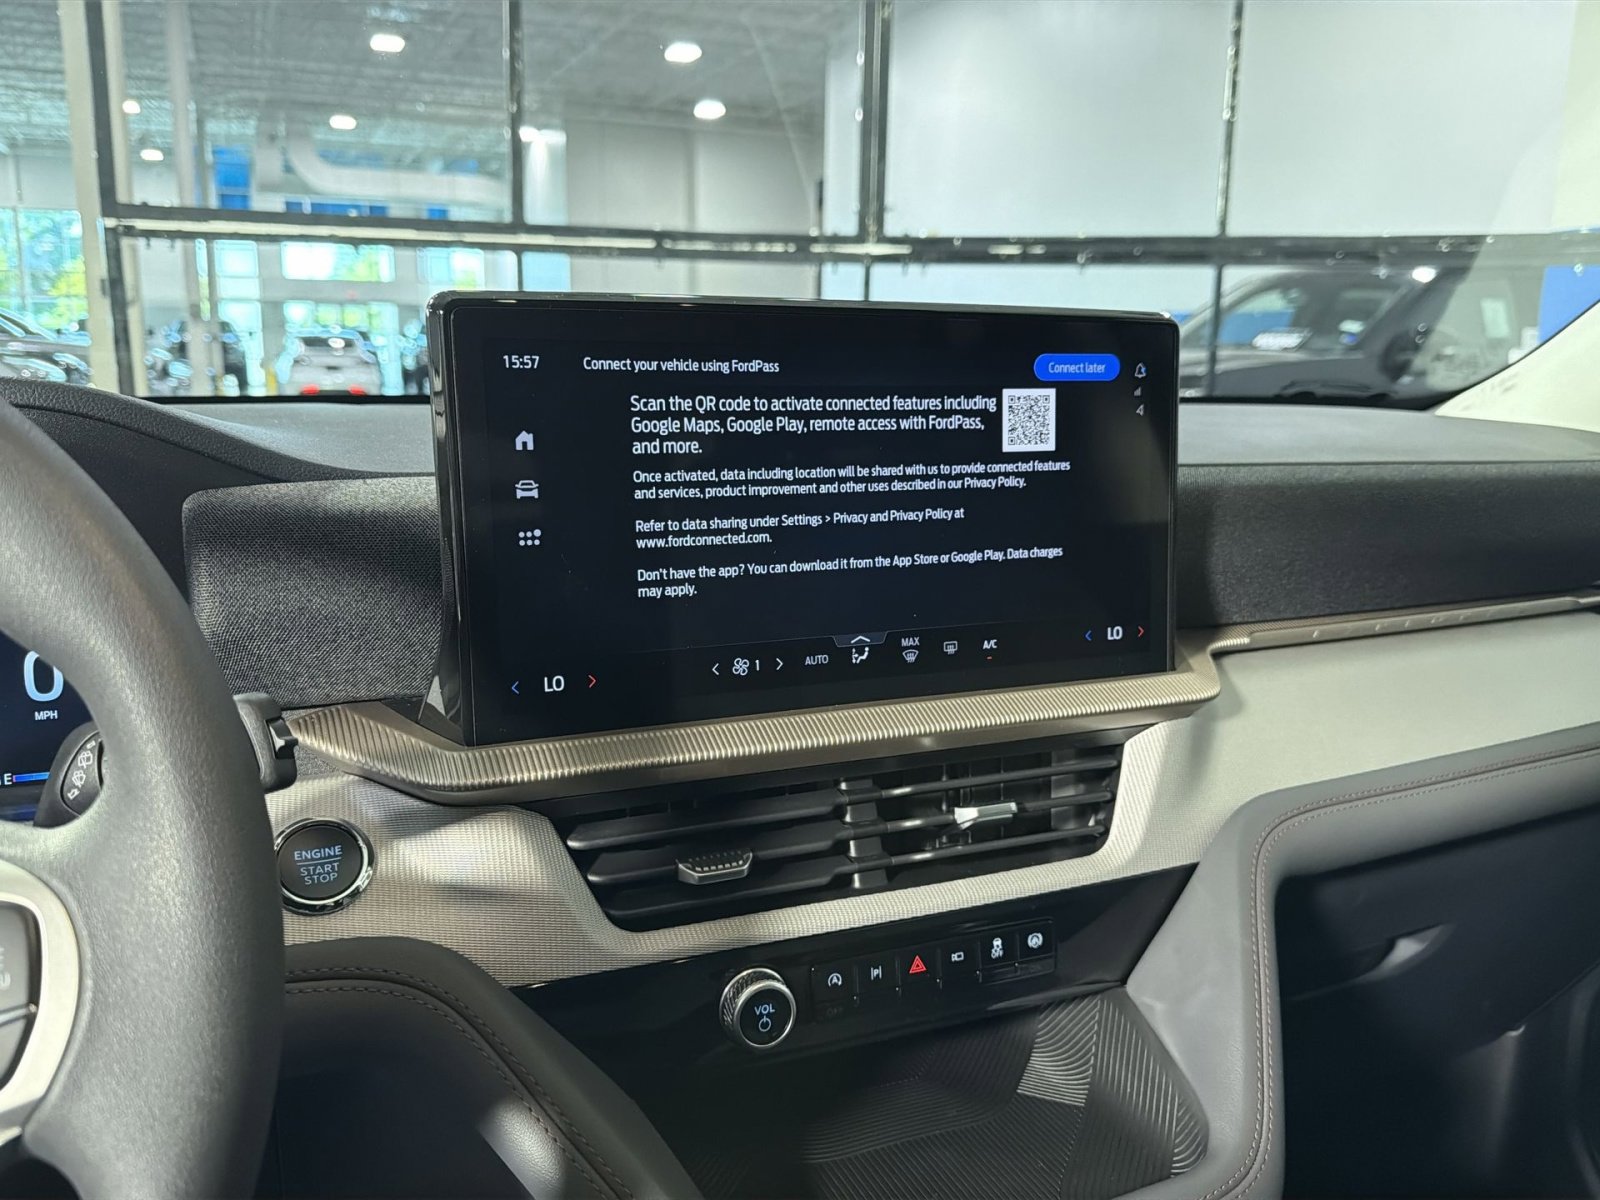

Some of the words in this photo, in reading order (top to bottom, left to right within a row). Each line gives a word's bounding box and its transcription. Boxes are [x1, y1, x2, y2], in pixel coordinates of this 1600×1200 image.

[502, 354, 540, 369] 15:57
[583, 356, 632, 371] Connect
[632, 360, 659, 373] your
[659, 357, 700, 372] vehicle
[700, 359, 731, 375] using
[731, 359, 780, 373] FordPass
[1047, 360, 1085, 375] Connect
[1085, 361, 1107, 375] later
[630, 394, 666, 412] Scan
[668, 395, 693, 412] the
[695, 395, 717, 414] QR
[718, 395, 751, 412] code
[753, 396, 769, 412] to
[770, 395, 824, 412] activate
[825, 395, 891, 411] connected
[892, 394, 943, 411] features
[944, 394, 997, 413] including
[631, 416, 681, 436] Google
[683, 416, 725, 435] Maps,
[726, 416, 774, 435] Google
[776, 416, 808, 434] Play,
[809, 416, 856, 432] remote
[857, 418, 898, 431] access
[898, 414, 927, 430] with
[928, 414, 985, 431] FordPass,
[632, 437, 660, 455] and
[662, 440, 703, 454] more.
[632, 470, 662, 483] Once
[663, 468, 719, 482] activated,
[720, 468, 746, 481] data
[747, 467, 794, 481] including
[794, 466, 837, 479] location
[837, 465, 856, 478] will
[856, 464, 870, 477] be
[870, 463, 904, 477] shared
[904, 463, 927, 476] with
[927, 465, 939, 475] us
[939, 463, 951, 475] to
[951, 461, 986, 476] provide
[986, 460, 1034, 473] connected
[1033, 459, 1071, 472] features
[634, 486, 656, 500] and
[657, 485, 704, 499] services,
[705, 484, 747, 500] product
[748, 482, 818, 498] improvement
[818, 481, 839, 494] and
[839, 480, 867, 493] other
[867, 482, 890, 492] uses
[890, 478, 936, 491] described
[937, 478, 947, 490] in
[947, 479, 963, 489] our
[964, 476, 997, 490] Privacy
[997, 475, 1027, 489] Policy.
[635, 519, 666, 533] Refer
[666, 519, 680, 531] to
[681, 517, 708, 531] data
[709, 516, 748, 531] sharing
[749, 514, 780, 528] under
[781, 513, 823, 528] Settings
[833, 511, 869, 525] Privacy
[869, 509, 889, 523] and
[889, 509, 925, 523] Privacy
[925, 507, 954, 521] Policy
[953, 507, 965, 519] at
[635, 531, 773, 549] www.fordconnected.com.
[637, 567, 668, 582] Don't
[669, 567, 697, 580] have
[697, 565, 717, 578] the
[718, 563, 745, 579] app?
[746, 562, 768, 575] You
[768, 563, 788, 574] can
[789, 557, 840, 573] download
[840, 558, 848, 570] it
[849, 556, 874, 569] from
[874, 555, 891, 568] the
[892, 554, 913, 568] App
[913, 553, 939, 565] Store
[939, 554, 951, 564] or
[950, 549, 983, 564] Google
[983, 549, 1006, 562] Play.
[1006, 547, 1029, 560] Data
[1029, 546, 1064, 559] charges
[637, 586, 663, 599] may
[664, 582, 698, 598] apply.
[1106, 625, 1124, 641] LO
[901, 636, 920, 647] MAX
[982, 639, 998, 650] A/C
[754, 659, 760, 671] 1
[804, 654, 830, 666] AUTO
[23, 650, 64, 702] 0
[543, 675, 566, 693] LO
[34, 709, 59, 721] MPH
[3, 772, 13, 786] E
[294, 845, 343, 861] ENGINE
[300, 862, 340, 877] START
[304, 872, 338, 885] STOP
[754, 1003, 776, 1017] VOL
